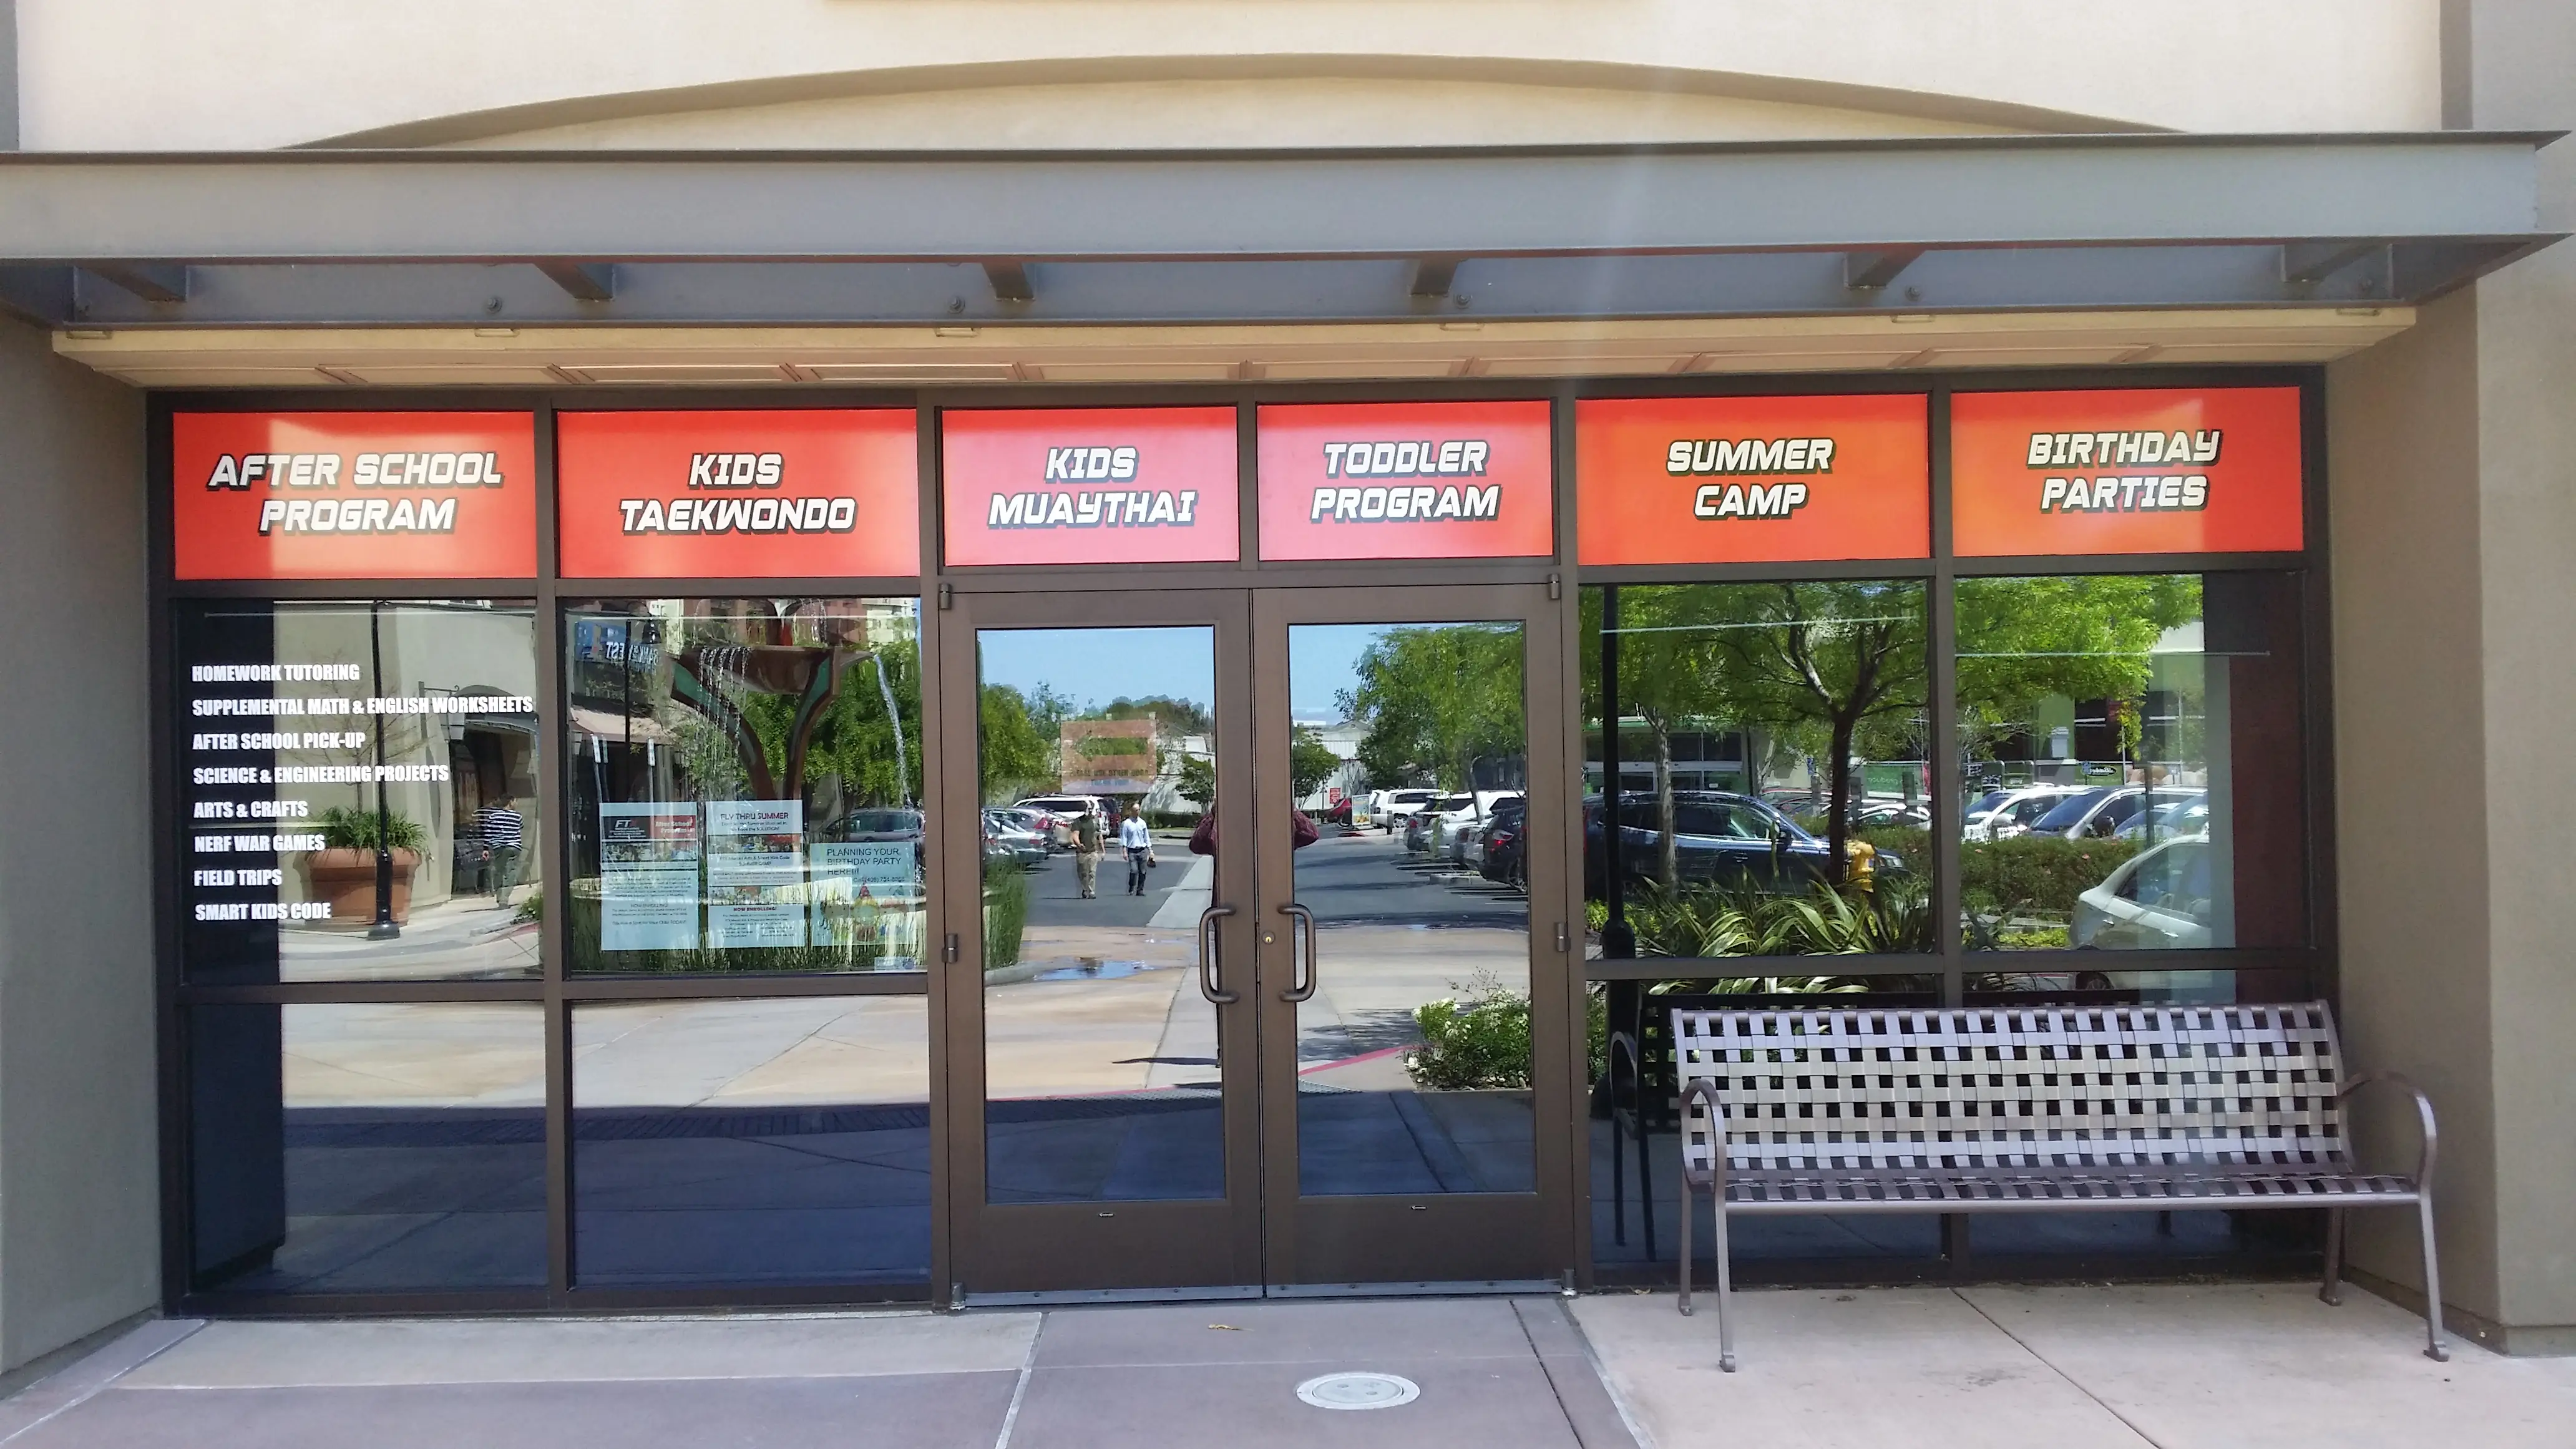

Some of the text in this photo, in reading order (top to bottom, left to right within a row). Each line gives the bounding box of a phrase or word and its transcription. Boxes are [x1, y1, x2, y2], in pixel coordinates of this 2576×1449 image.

[1324, 441, 1490, 477] TODDLER
[1667, 439, 1834, 475] SUMMER
[2027, 431, 2220, 466] BIRTHDAY
[208, 452, 502, 487] AFTER SCHOOL
[688, 453, 783, 488] KIDS
[1045, 446, 1138, 482] KIDS
[1310, 485, 1501, 522] PROGRAM
[1692, 483, 1807, 519] CAMP
[2040, 475, 2208, 510] PARTIES
[258, 497, 457, 534] PROGRAM
[620, 497, 857, 533] TAEKWONDO
[988, 490, 1198, 528] MUAYTHAI
[192, 664, 359, 681] HOMEWORK TUTORING
[192, 696, 534, 716] SUPPLEMENTAL MATH & ENGLISH WORKSHEETS
[192, 732, 366, 749] AFTER SCHOOL PICK-UP
[193, 764, 449, 784] SCIENCE & ENGINEERING PROJECTS
[193, 801, 308, 818] ARTS & CRAFTS
[758, 812, 789, 820] SUMMER
[194, 834, 325, 852] NERF WAR GAMES
[826, 847, 900, 856] PLANNING YOUR
[827, 857, 902, 866] BIRTHDAY PARTY
[827, 867, 860, 876] HERE!!!
[193, 869, 283, 886] FIELD TRIPS
[195, 902, 331, 920] SMART KIDS CODE
